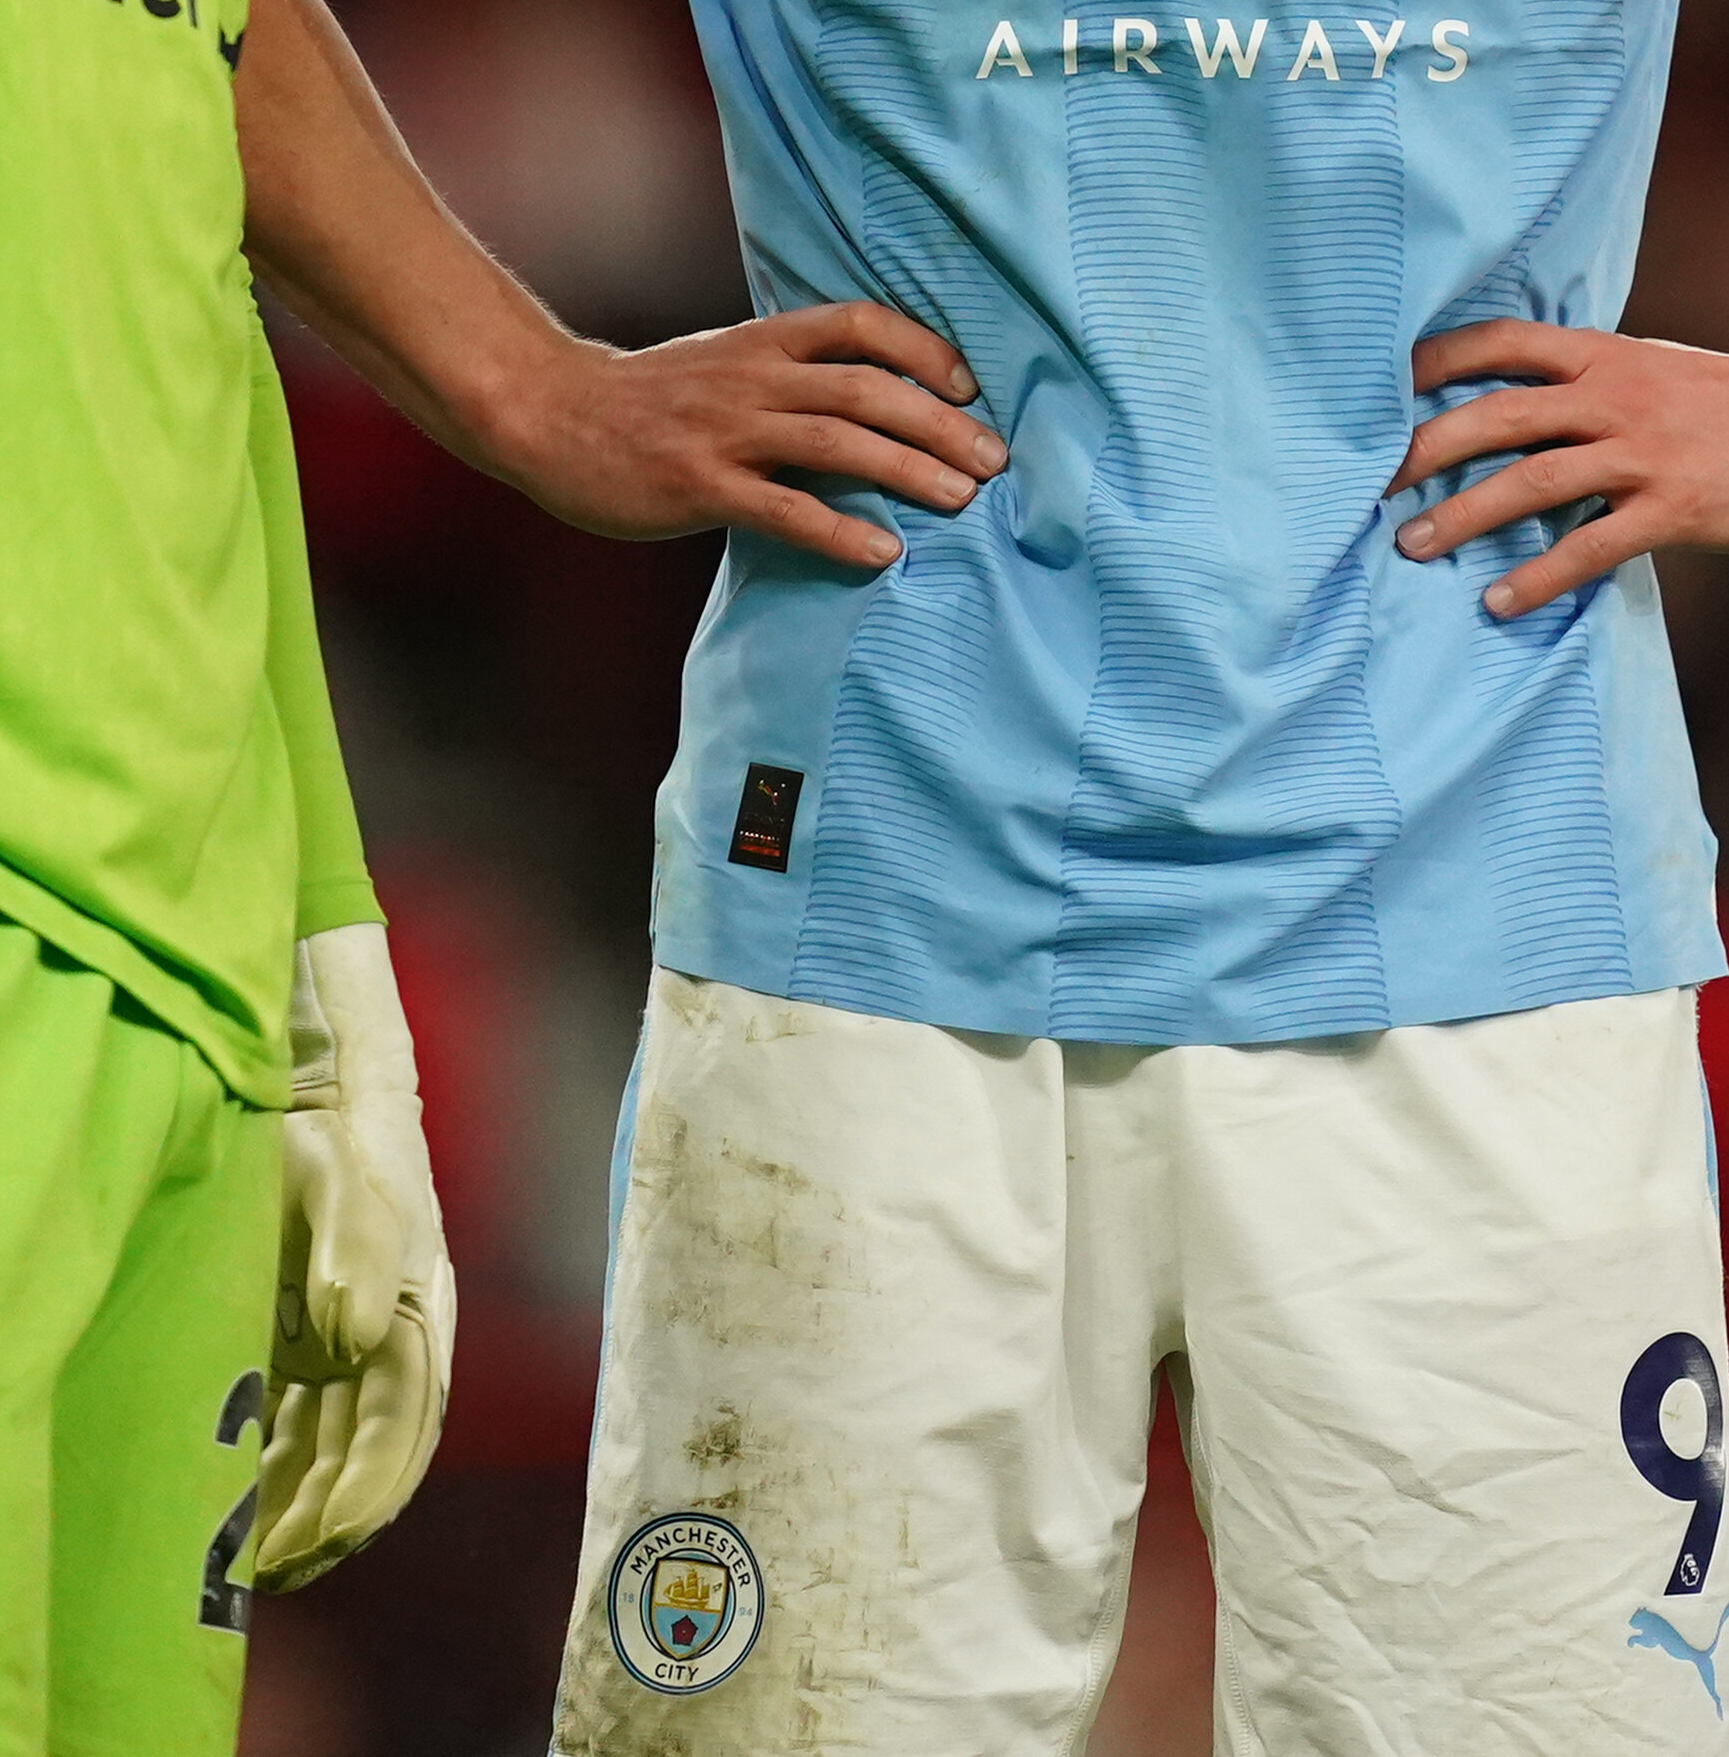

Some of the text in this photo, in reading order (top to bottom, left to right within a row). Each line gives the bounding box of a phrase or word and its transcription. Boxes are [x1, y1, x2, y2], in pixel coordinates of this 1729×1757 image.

[975, 18, 1471, 83] AIRWAYS
[1619, 1330, 1726, 1596] 9
[630, 1527, 751, 1588] MANCHESTER
[655, 1663, 699, 1682] CITY
